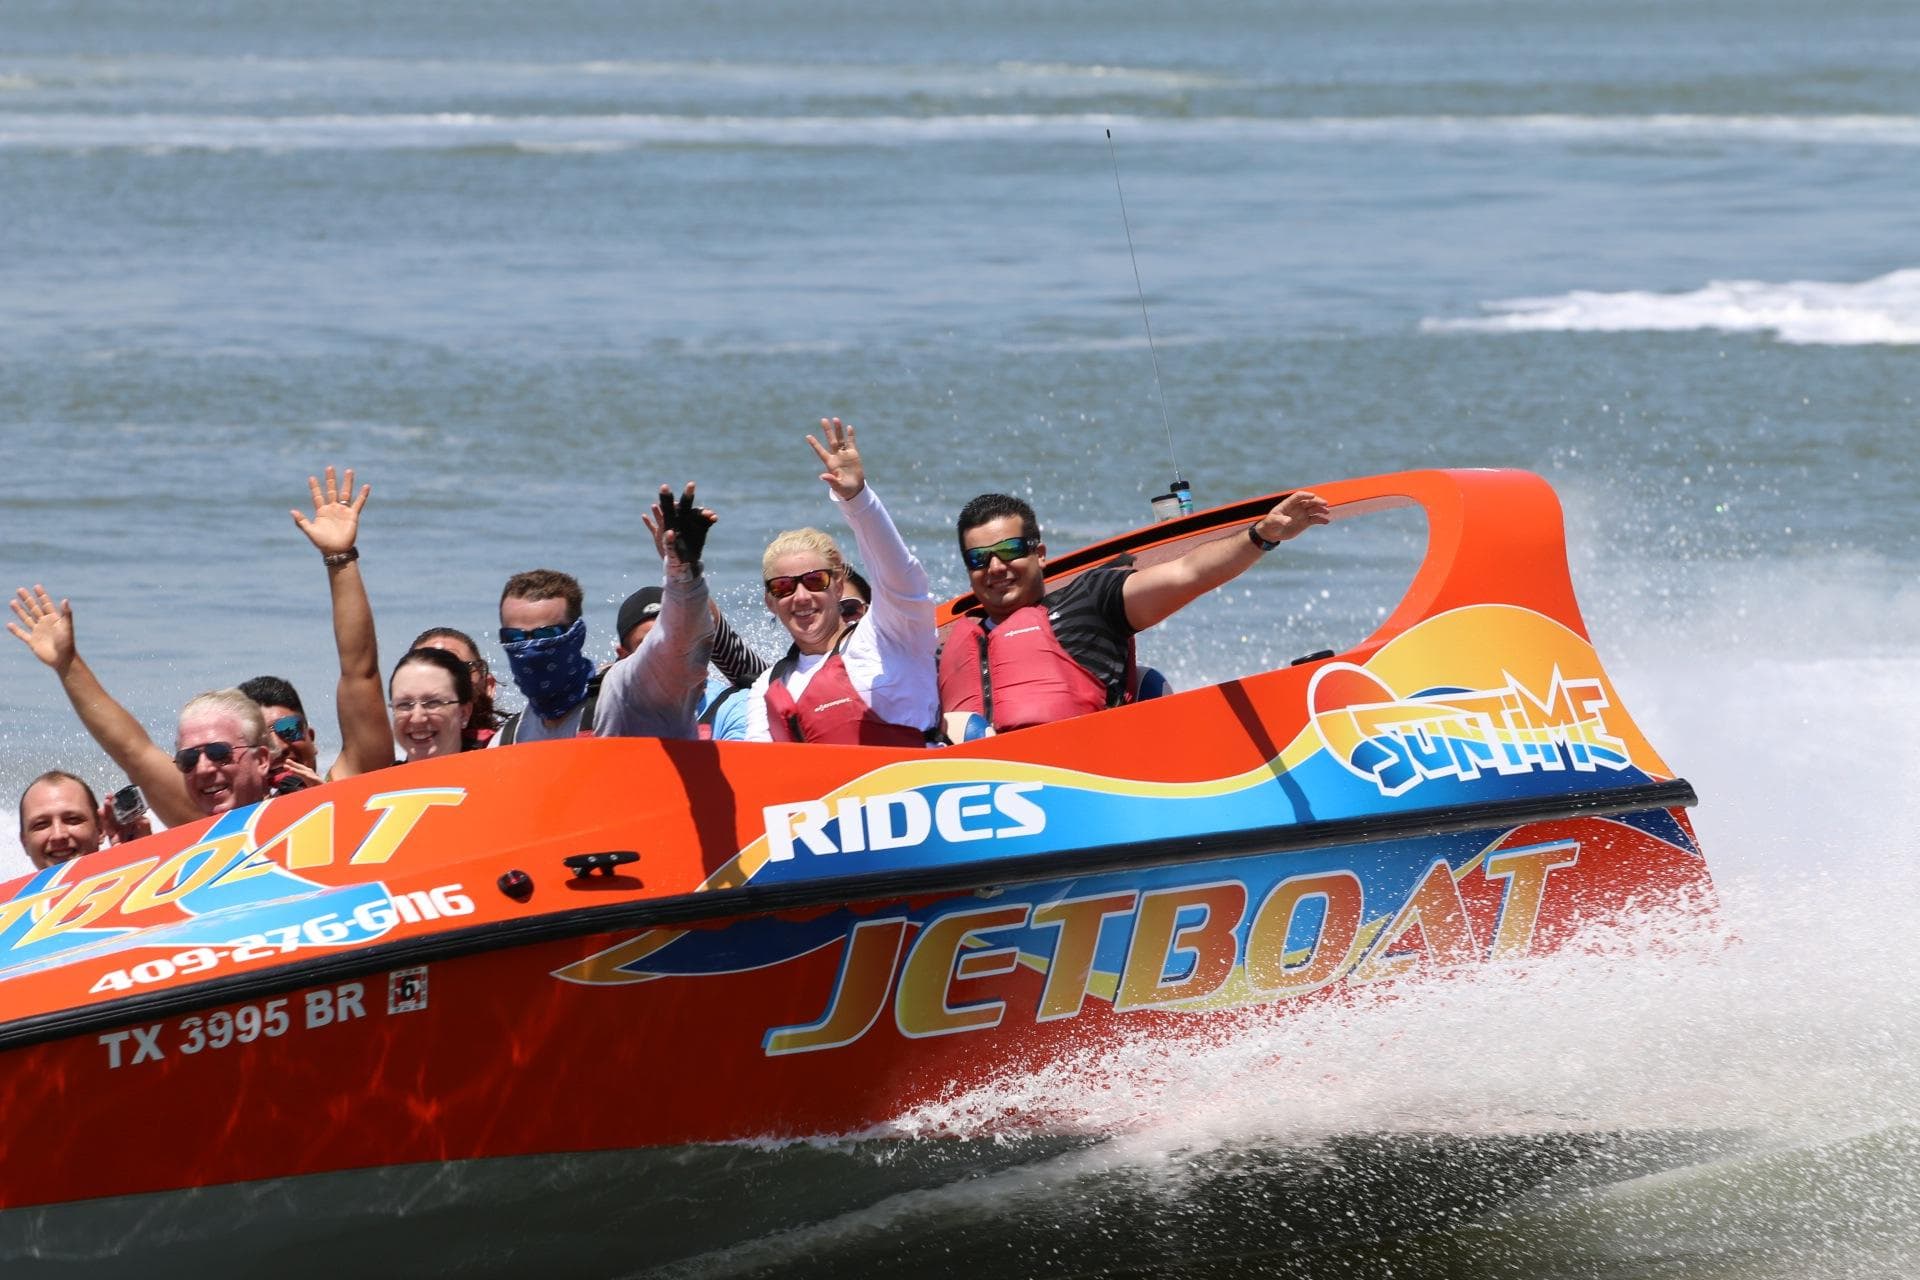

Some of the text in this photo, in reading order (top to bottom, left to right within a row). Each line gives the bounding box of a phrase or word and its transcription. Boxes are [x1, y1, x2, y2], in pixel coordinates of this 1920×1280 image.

[763, 781, 1046, 862] RIDES
[88, 883, 475, 994] 409-276-6116
[761, 838, 1581, 1056] JETBOAT
[99, 982, 366, 1069] TX 3995 BR
